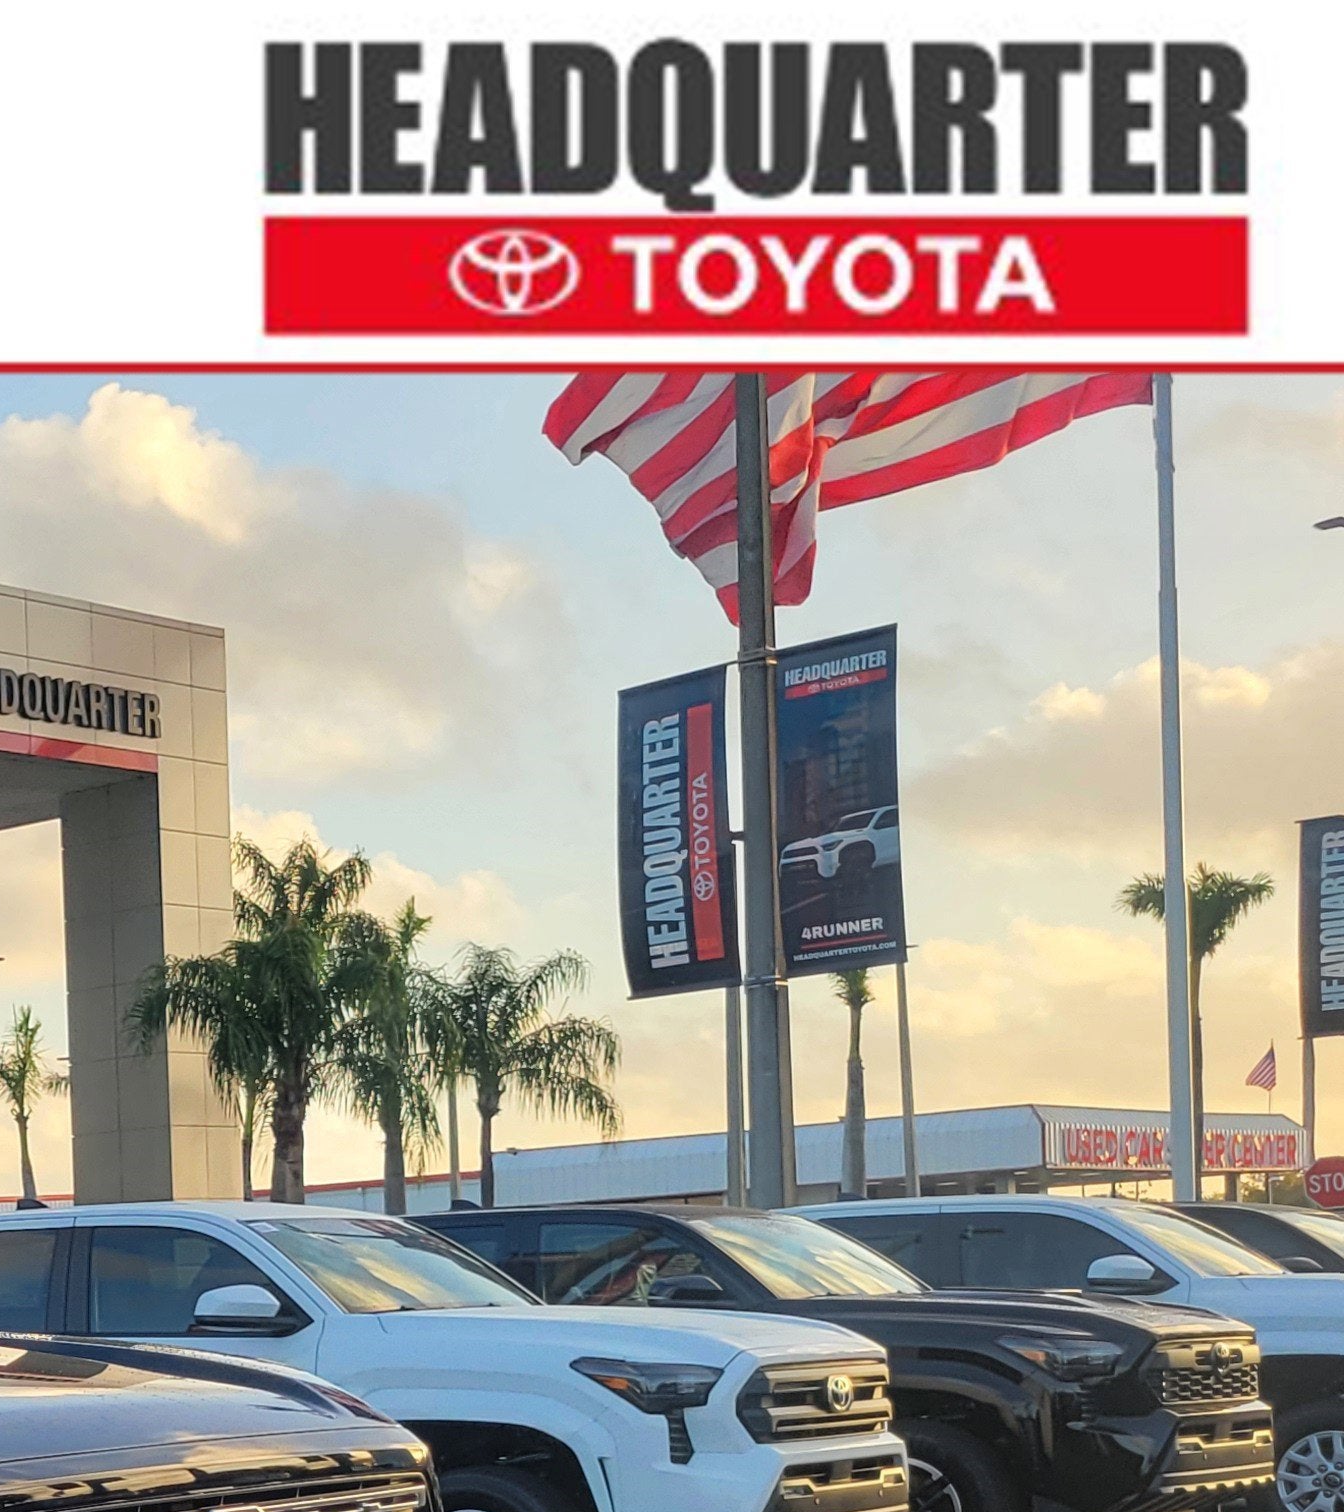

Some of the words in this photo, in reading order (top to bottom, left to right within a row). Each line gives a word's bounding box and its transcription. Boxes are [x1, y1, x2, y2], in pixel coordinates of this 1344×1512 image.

[784, 650, 887, 687] HEADQUARTER
[821, 675, 860, 691] TOYOTA
[692, 772, 714, 869] TOYOTA
[642, 713, 690, 969] HEADQUARTER
[801, 917, 883, 940] 4RUNNER
[793, 941, 897, 961] HEADQUARTERTOYOTA.COM
[1066, 1129, 1118, 1164] USED
[1124, 1130, 1165, 1165] CAR
[1231, 1133, 1297, 1167] CENTER
